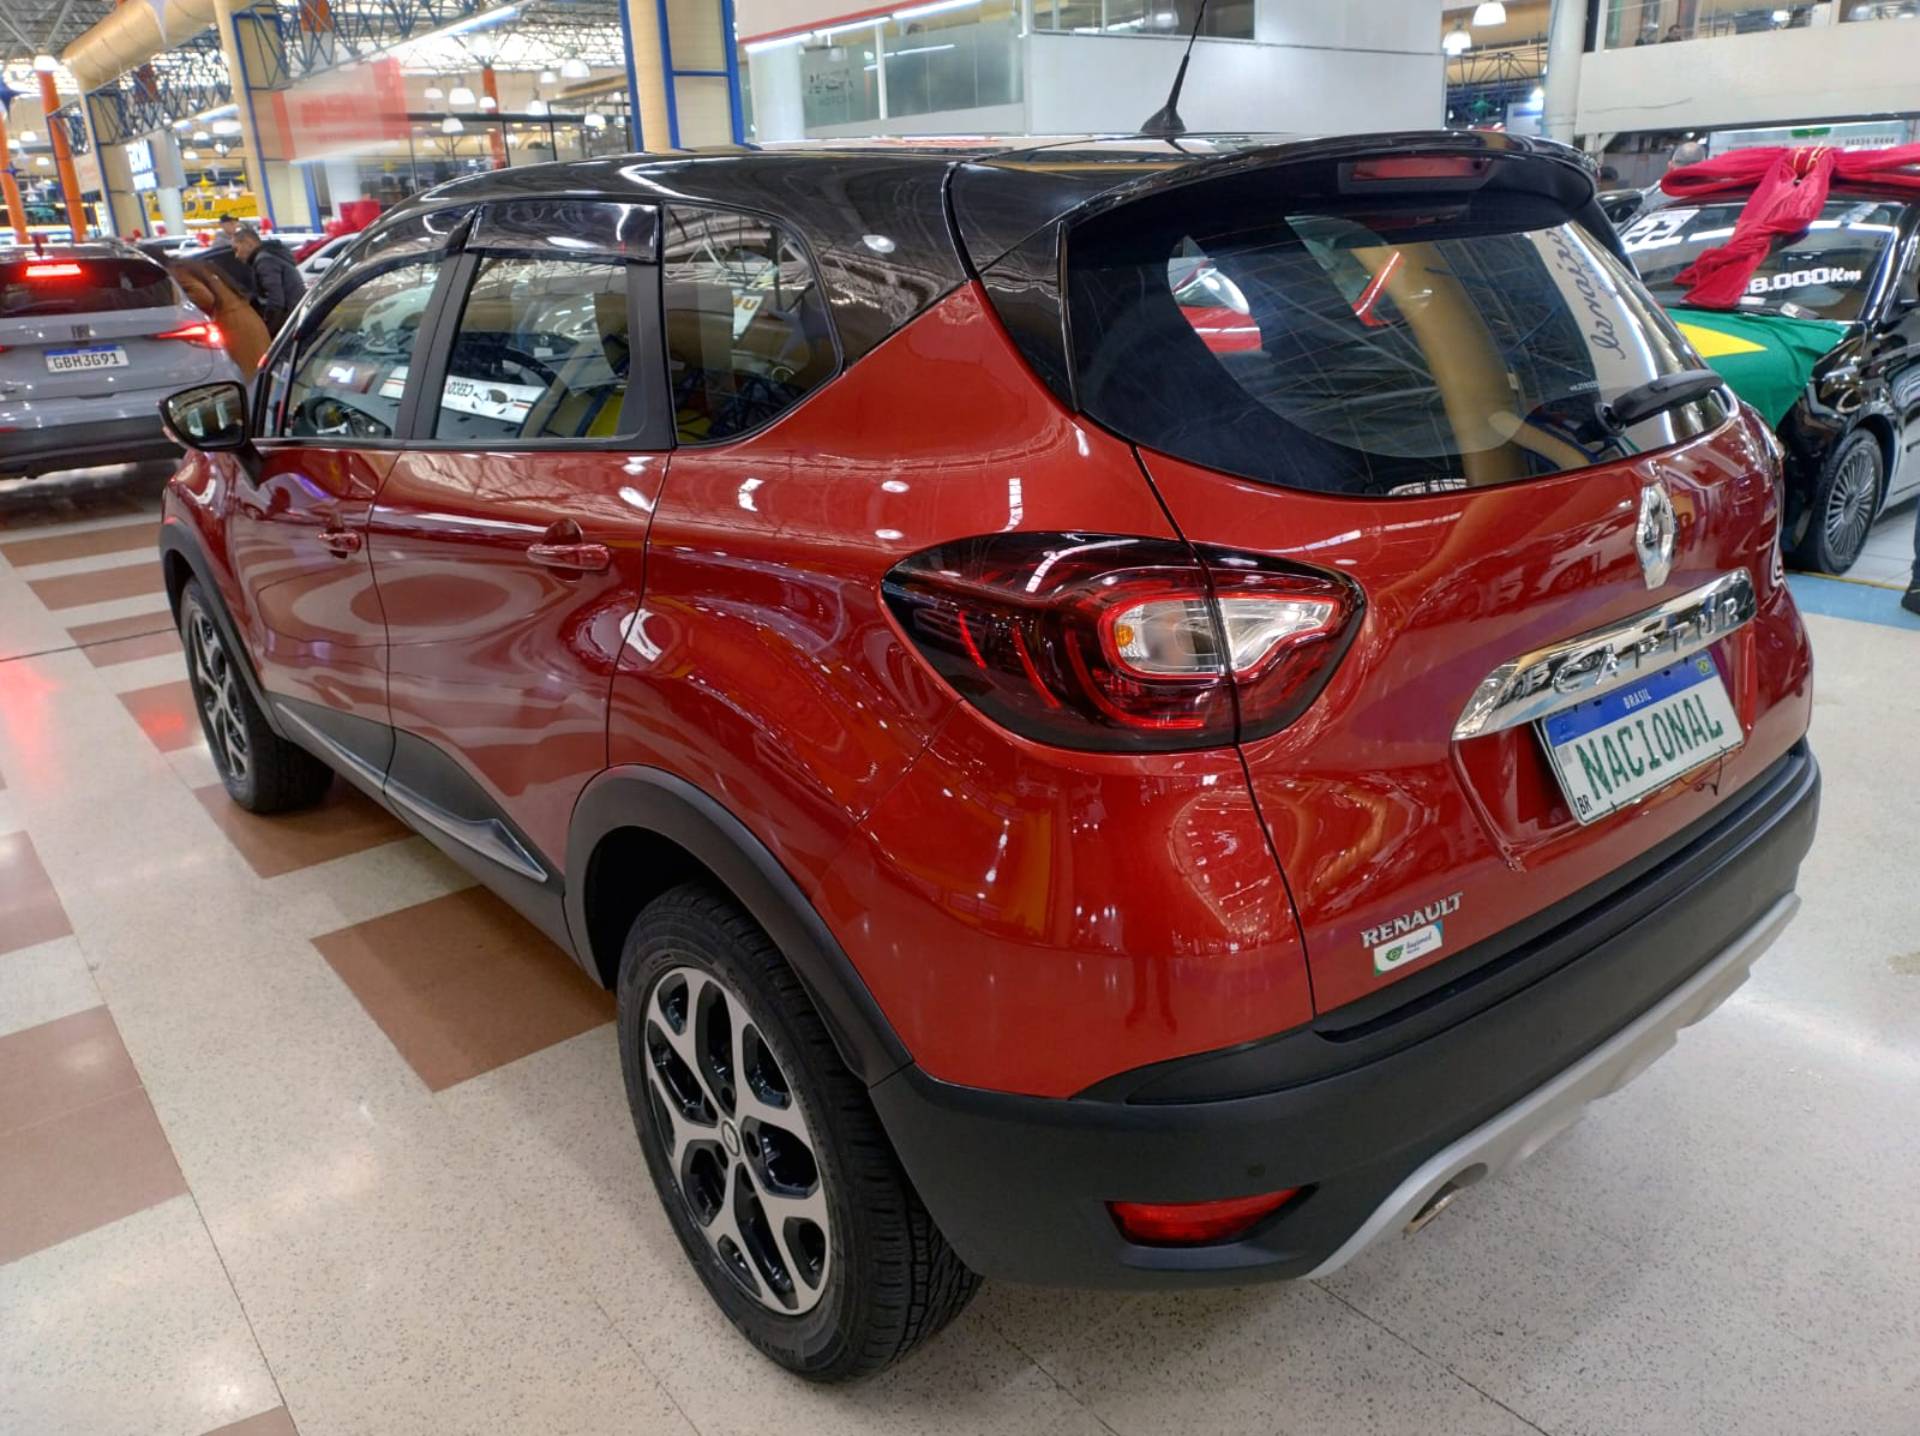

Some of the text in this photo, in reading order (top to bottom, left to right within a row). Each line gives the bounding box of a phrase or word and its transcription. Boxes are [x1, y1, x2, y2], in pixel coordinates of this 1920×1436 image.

[1743, 267, 1862, 294] 8.000Km
[53, 352, 120, 370] GBH3G91
[1553, 597, 1739, 694] CAPTUR
[1623, 688, 1652, 710] BRASIL
[1575, 693, 1724, 800] NACIONAL
[1576, 793, 1593, 814] BR
[1361, 891, 1464, 949] RENAULT
